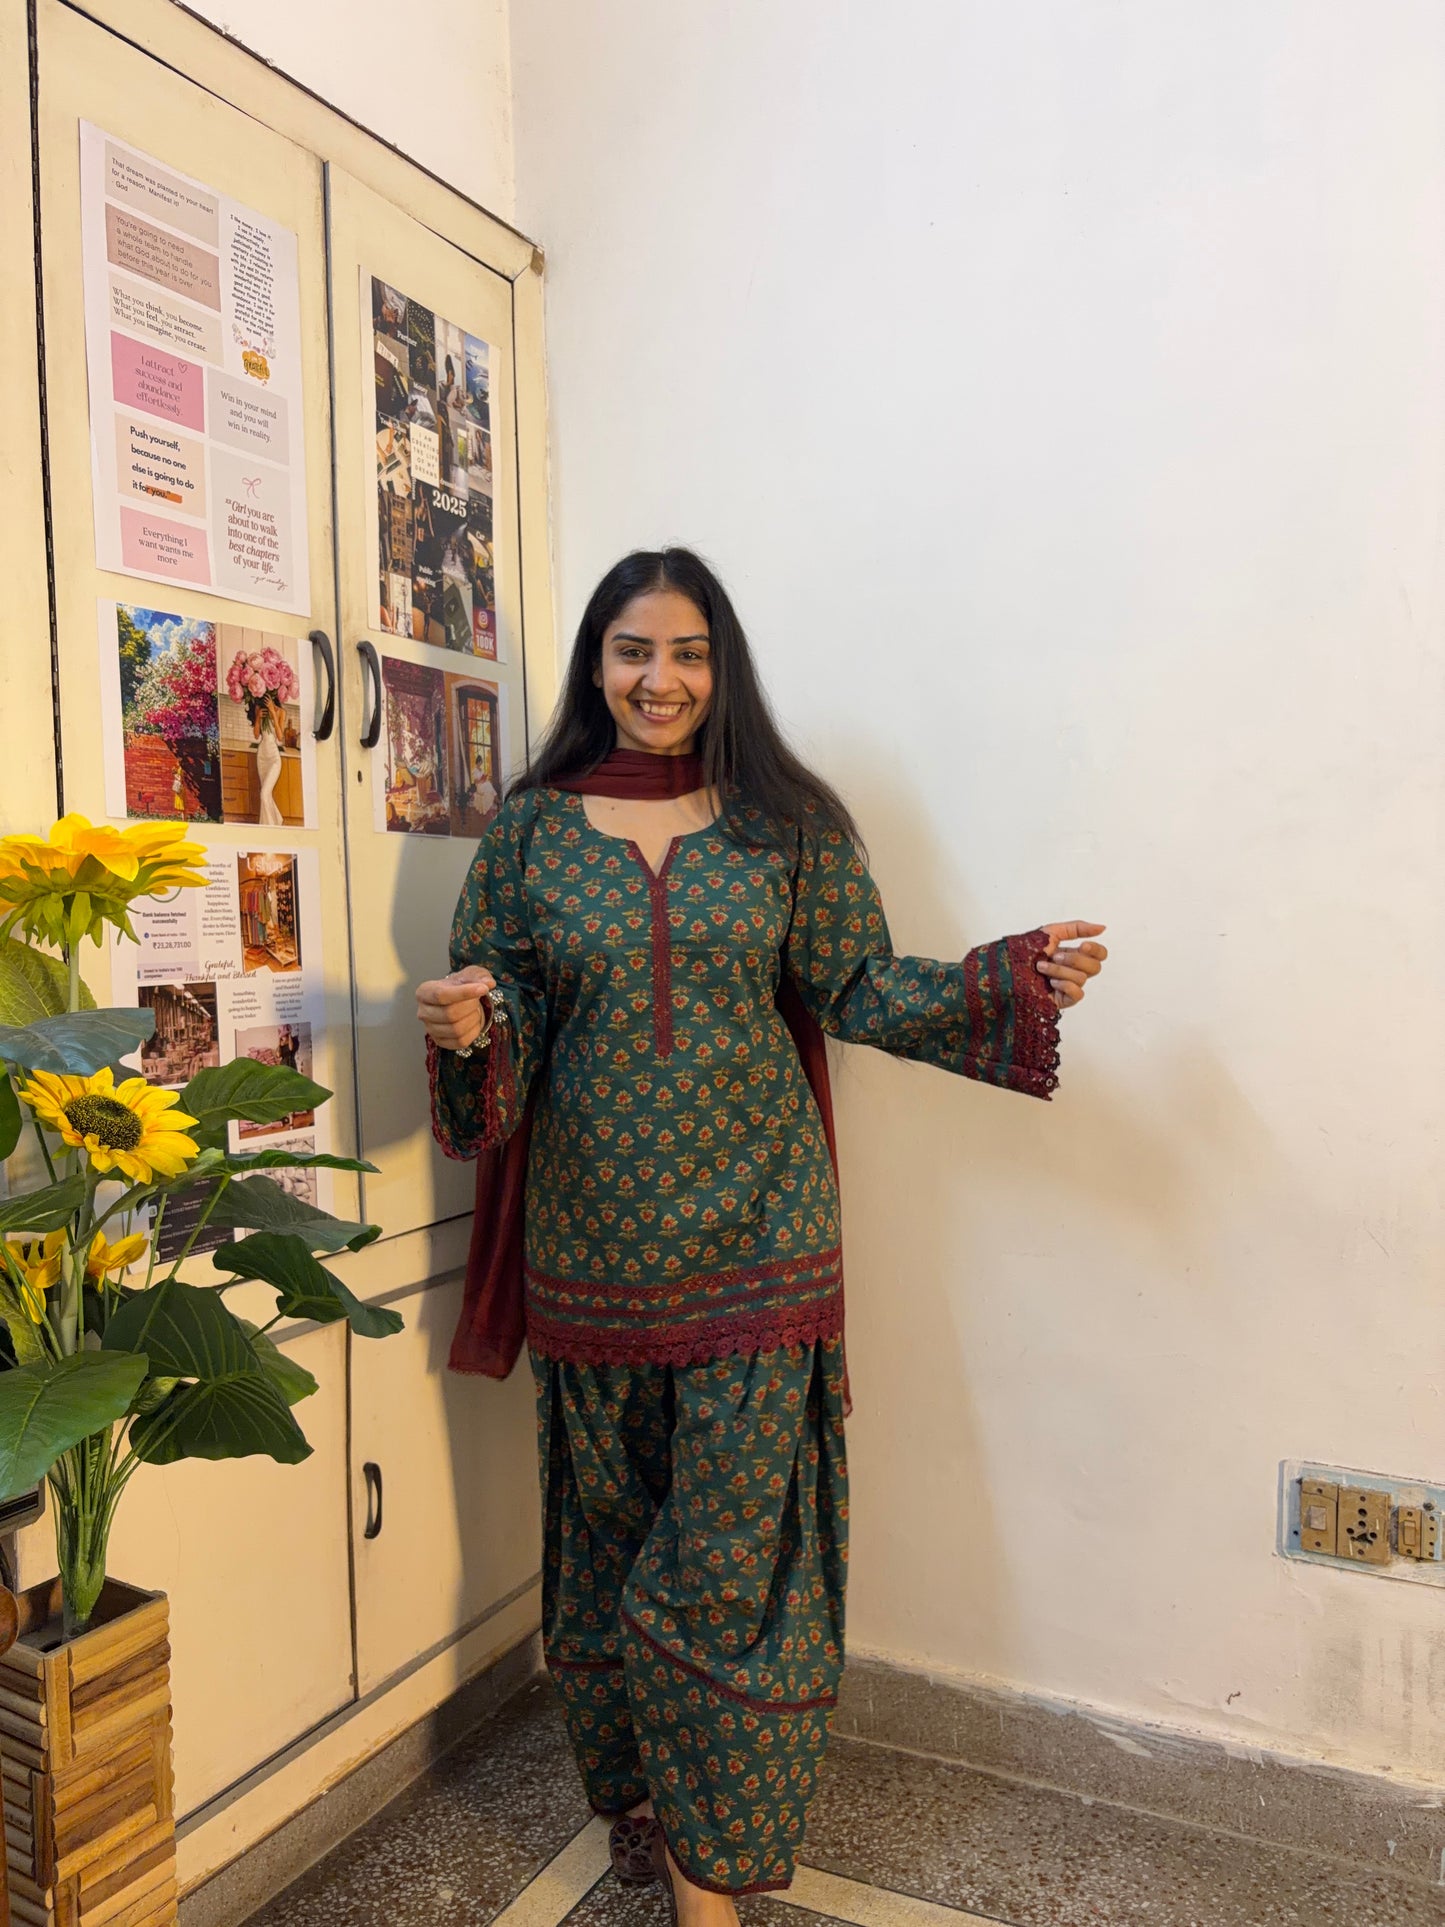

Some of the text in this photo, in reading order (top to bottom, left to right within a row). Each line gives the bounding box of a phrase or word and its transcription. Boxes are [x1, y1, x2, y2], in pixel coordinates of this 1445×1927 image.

[111, 168, 120, 176] for
[148, 187, 172, 205] Manifest
[112, 157, 124, 169] That
[126, 166, 143, 179] dream
[145, 176, 156, 185] was
[157, 183, 178, 197] planted
[186, 197, 198, 206] your
[199, 203, 213, 214] heart
[115, 181, 128, 191] God
[116, 215, 185, 254] You're going to need
[123, 231, 143, 245] whole
[144, 241, 161, 252] team
[162, 249, 169, 257] to
[170, 253, 193, 269] handle
[117, 248, 140, 265] before
[141, 260, 154, 271] this
[155, 267, 170, 277] year
[171, 273, 177, 282] is
[179, 278, 193, 289] over
[118, 239, 134, 251] what
[135, 246, 150, 259] God
[151, 254, 171, 269] about
[171, 264, 179, 272] to
[180, 268, 189, 277] do
[190, 272, 199, 281] for
[200, 280, 212, 288] you
[112, 286, 131, 302] What
[132, 297, 144, 307] you
[166, 312, 178, 321] you
[112, 296, 131, 311] What
[132, 307, 145, 316] you
[160, 319, 173, 329] you
[113, 306, 132, 321] What
[133, 317, 145, 326] you
[174, 334, 187, 343] you
[145, 359, 174, 376] attract
[135, 368, 183, 391] success and
[138, 380, 181, 402] abundance
[136, 391, 183, 417] effortlessly.
[221, 391, 277, 419] Win in your mind
[227, 420, 241, 430] win
[241, 425, 249, 434] in
[230, 409, 269, 429] and you will
[130, 425, 181, 452] Push yourself,
[131, 443, 187, 470] because no one
[131, 463, 195, 490] else is going to do
[132, 480, 138, 489] it
[139, 481, 149, 493] for
[247, 507, 261, 519] you
[262, 512, 275, 523] are
[432, 490, 467, 518] 2025
[228, 513, 278, 537] about to walk
[138, 539, 194, 558] want wants me
[143, 527, 184, 547] Everything
[227, 526, 279, 549] into one of the
[157, 555, 178, 565] more
[229, 539, 280, 562] best chapters
[233, 554, 275, 574] of your life.
[475, 634, 494, 651] 100K
[217, 972, 231, 980] and
